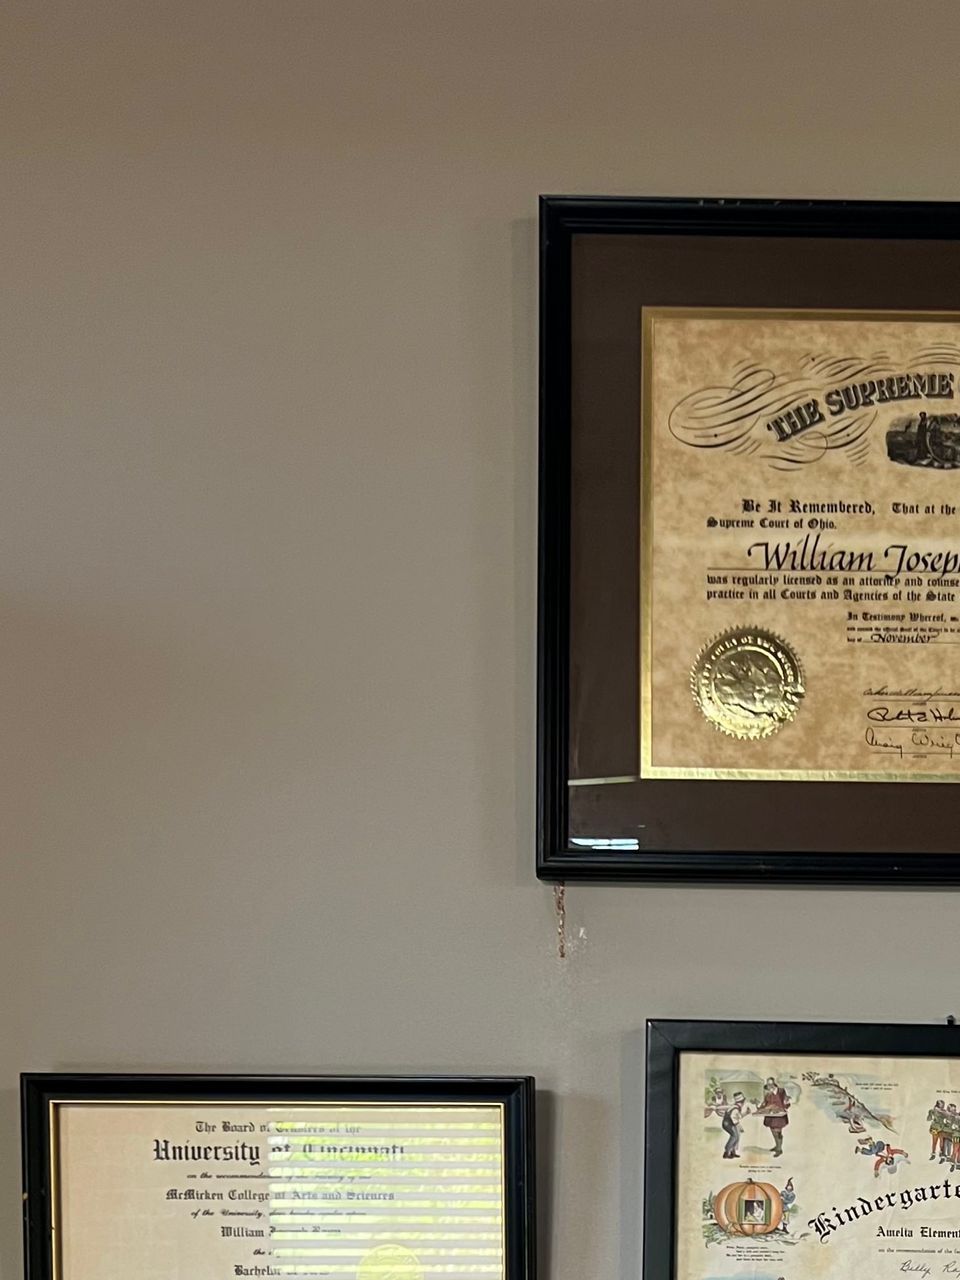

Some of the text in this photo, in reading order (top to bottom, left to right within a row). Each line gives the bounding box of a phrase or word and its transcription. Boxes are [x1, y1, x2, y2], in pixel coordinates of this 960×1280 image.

[767, 399, 826, 442] THE
[826, 373, 954, 416] SUPREME
[742, 499, 760, 513] Be
[768, 499, 781, 513] It
[789, 499, 875, 515] Remembered,
[892, 502, 919, 514] That
[925, 503, 935, 514] at
[941, 504, 955, 515] the
[706, 518, 837, 530] Supreme Court of Ohio.
[748, 533, 875, 571] William
[707, 574, 728, 585] was
[732, 575, 779, 586] regularly
[783, 575, 822, 585] licensed
[826, 577, 838, 586] as
[842, 577, 855, 586] an
[859, 576, 900, 588] attorney
[905, 576, 922, 586] and
[847, 612, 858, 621] In
[862, 612, 905, 623] Testimony
[909, 613, 946, 623] Whereof,
[871, 633, 940, 643] November
[195, 1121, 217, 1135] The
[222, 1121, 255, 1132] Board
[153, 1139, 260, 1165] University
[166, 1189, 223, 1200] McMicken
[228, 1189, 270, 1201] College
[221, 1227, 264, 1238] William
[876, 1226, 913, 1238] Amelia
[900, 1260, 931, 1278] Billy
